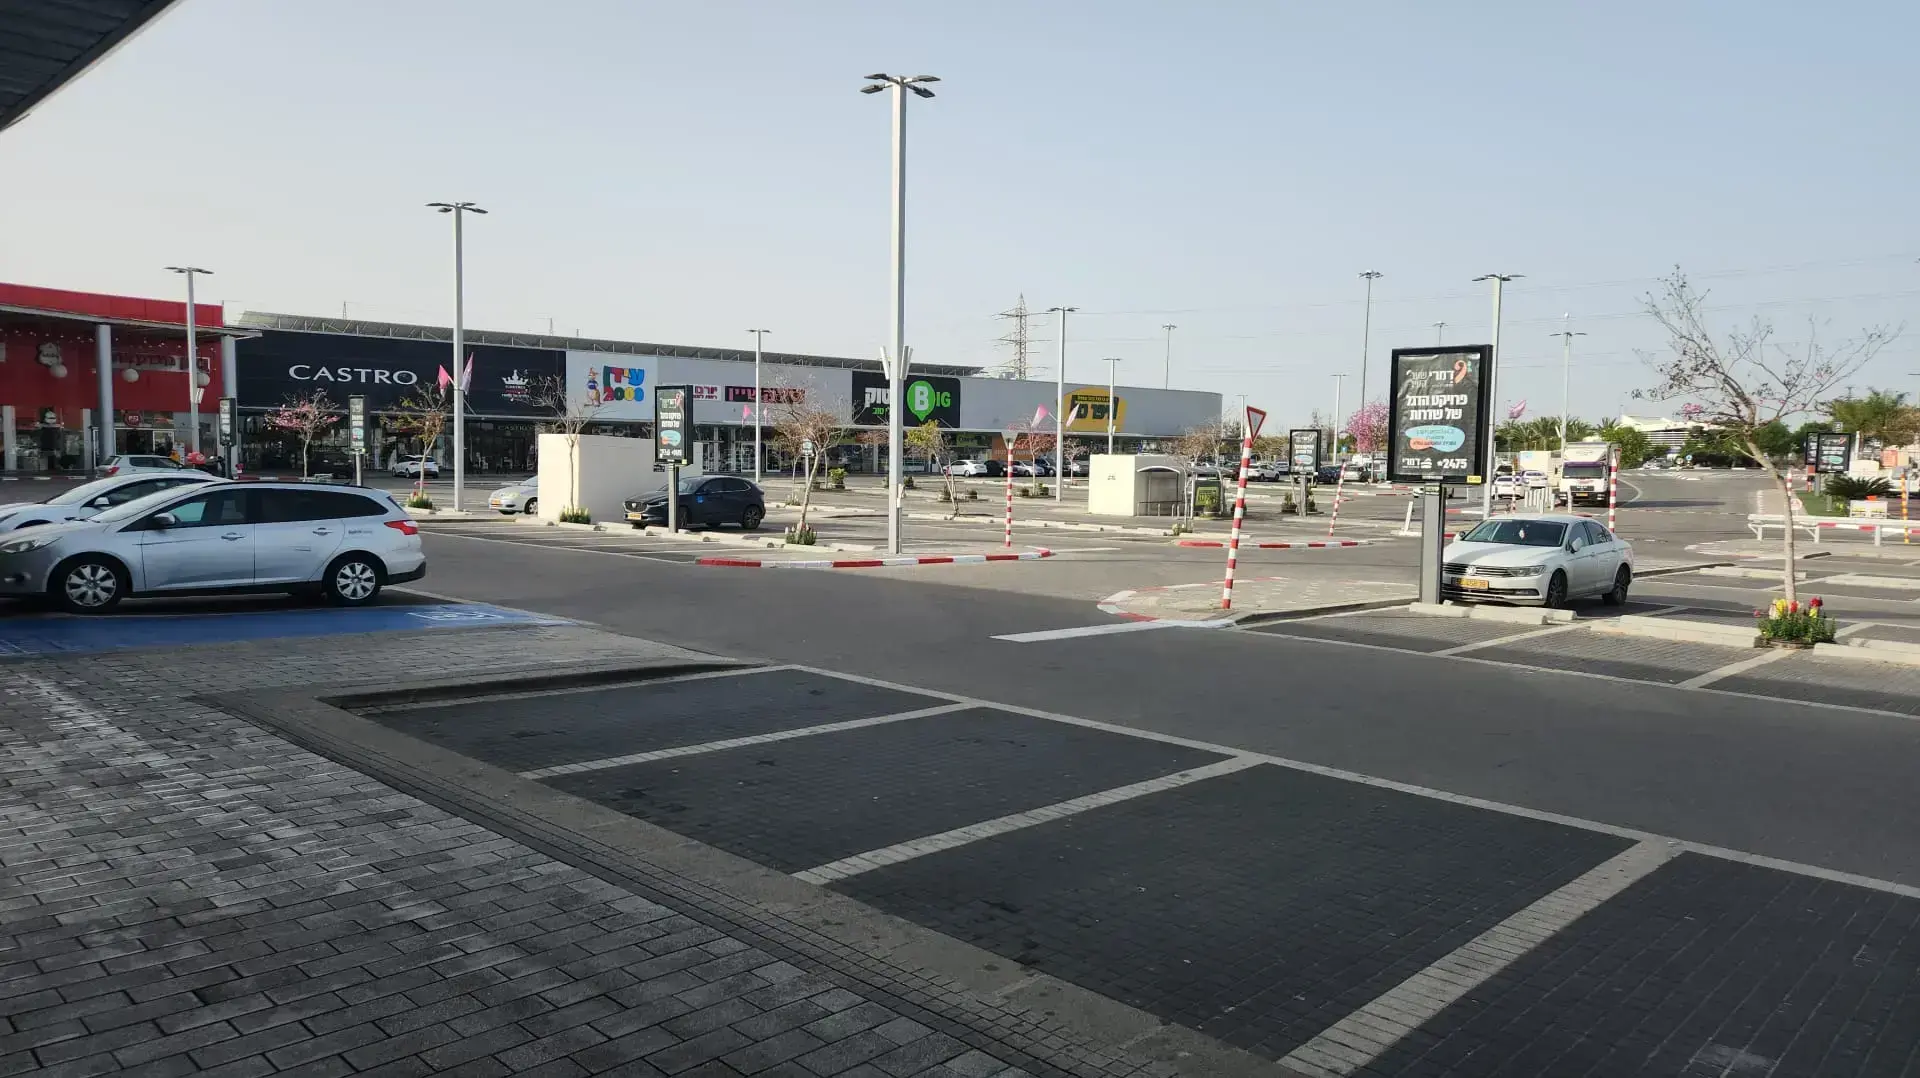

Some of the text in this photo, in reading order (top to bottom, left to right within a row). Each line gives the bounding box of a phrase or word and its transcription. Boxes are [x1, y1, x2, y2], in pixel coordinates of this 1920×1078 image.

[288, 364, 418, 385] CASTRO
[603, 365, 645, 386] עידן
[1429, 370, 1454, 383] דמרי
[603, 386, 645, 402] 2000
[914, 385, 951, 411] BIG
[1406, 394, 1468, 408] פרויקט הדגל
[1409, 407, 1463, 421] של שדרות
